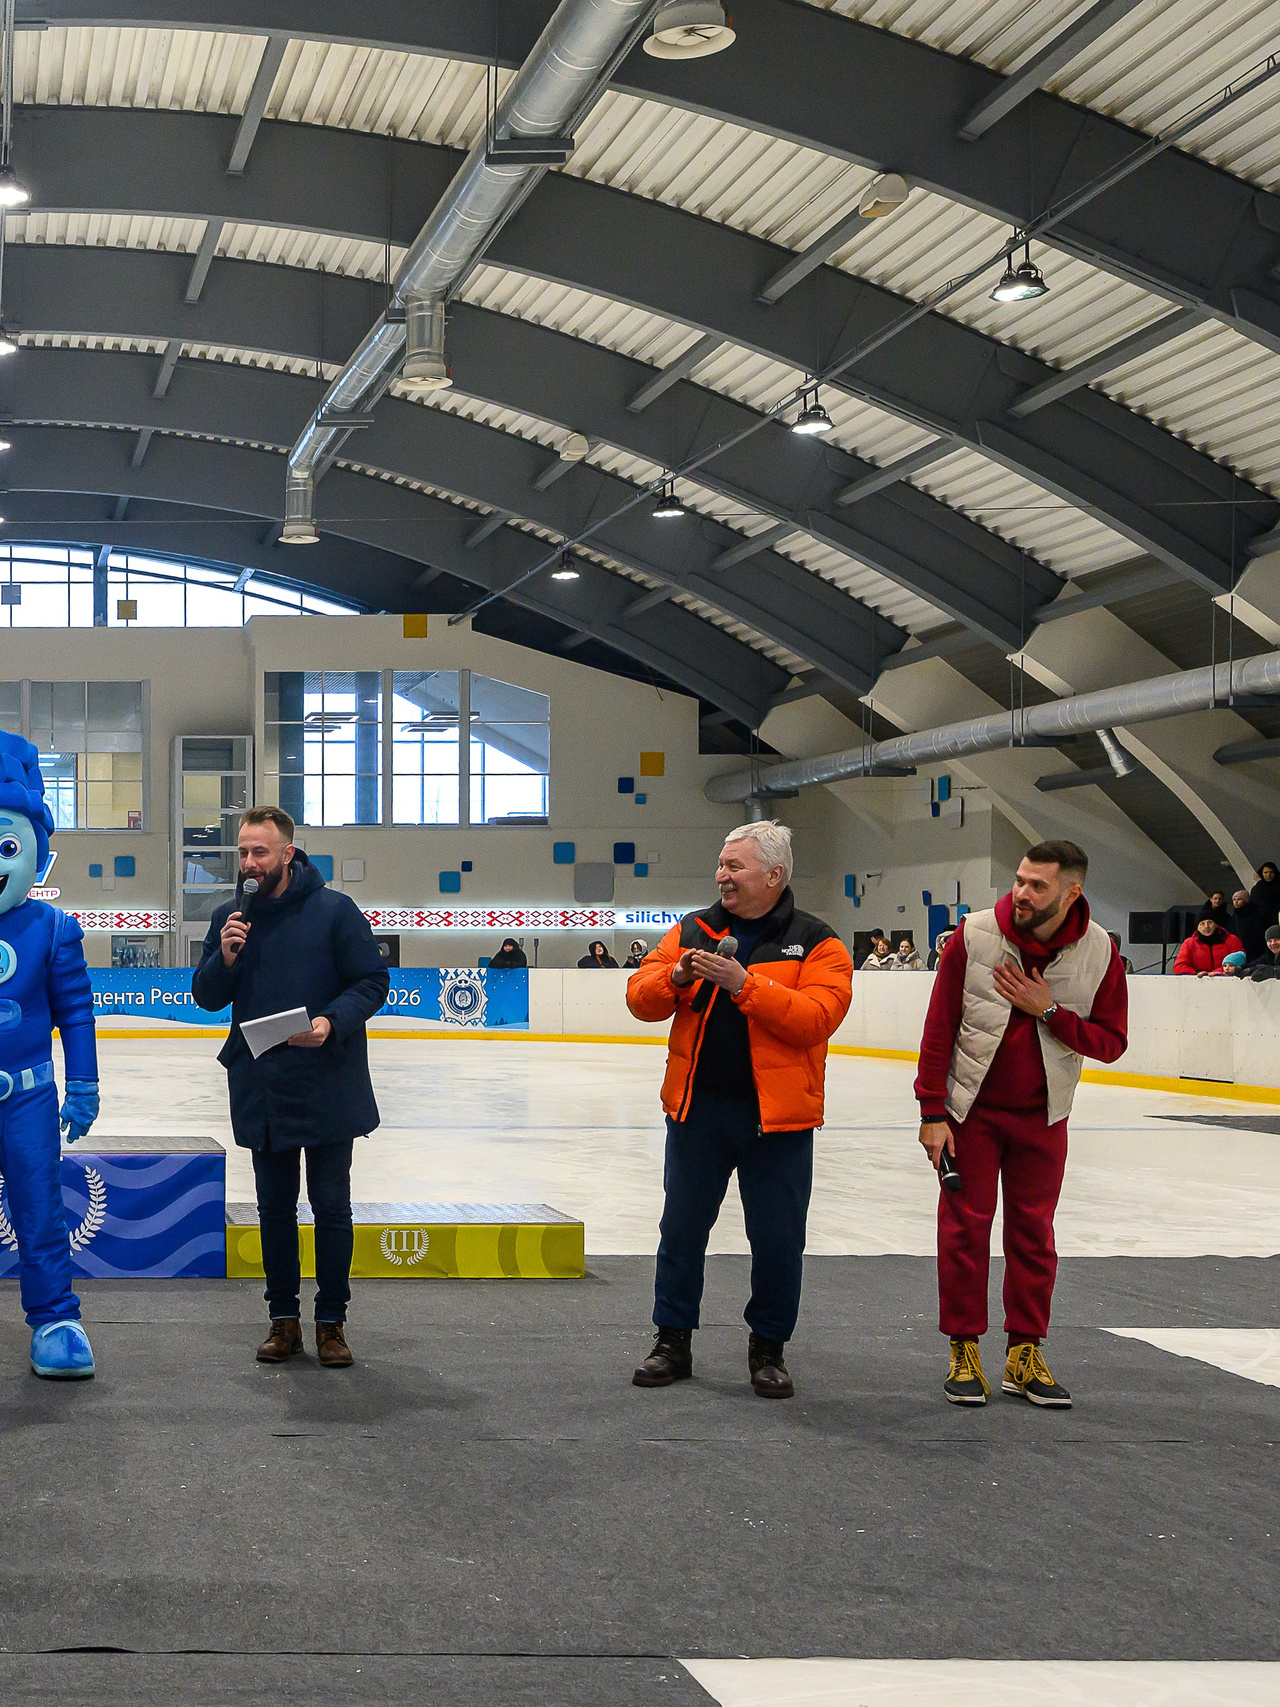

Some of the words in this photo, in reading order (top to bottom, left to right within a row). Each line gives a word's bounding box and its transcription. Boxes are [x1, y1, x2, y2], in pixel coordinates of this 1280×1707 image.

[26, 890, 58, 898] ЕНТР
[625, 911, 684, 924] silichy
[92, 992, 145, 1008] дента
[386, 989, 421, 1006] 026
[388, 1230, 421, 1252] III
